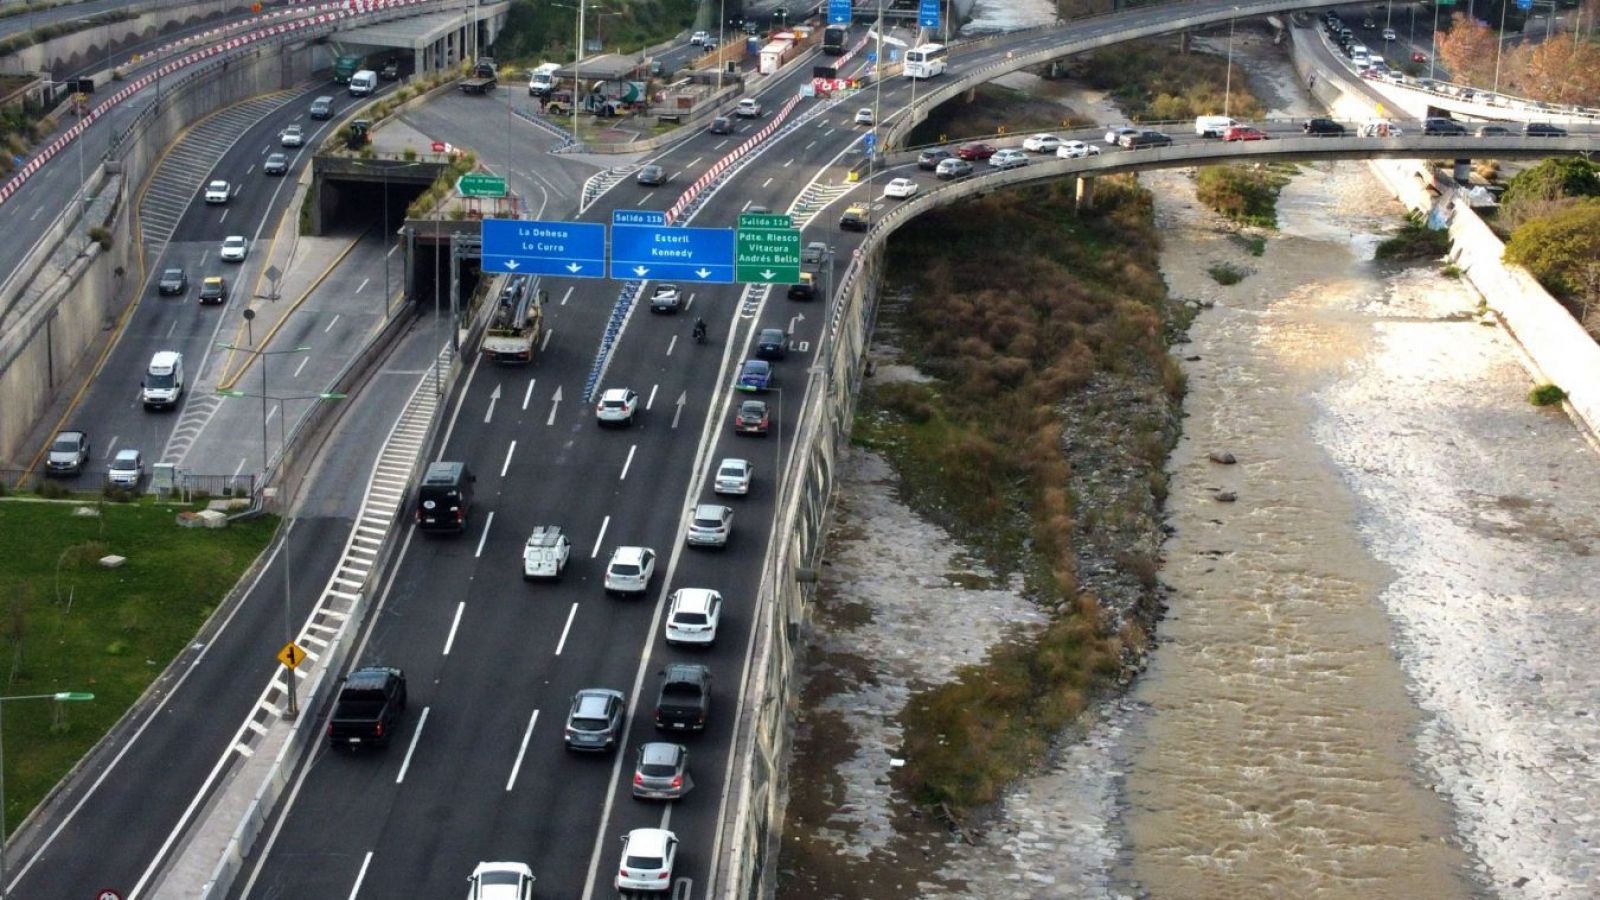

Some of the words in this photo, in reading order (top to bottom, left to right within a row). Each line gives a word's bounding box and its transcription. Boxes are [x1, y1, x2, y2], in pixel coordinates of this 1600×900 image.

[615, 213, 643, 222] Salida
[646, 215, 662, 223] 11b
[741, 217, 770, 225] Salida
[773, 218, 789, 226] 11a
[519, 228, 530, 236] La
[532, 228, 568, 238] Dehesa
[655, 233, 689, 243] Estoril
[739, 232, 764, 241] Pdte.
[767, 233, 798, 242] Riesco
[522, 242, 534, 250] Lo
[537, 242, 564, 252] Curro
[749, 244, 789, 252] Vitacura
[652, 247, 693, 258] Kennedy
[739, 253, 771, 262] Andrés
[774, 254, 799, 263] Bello
